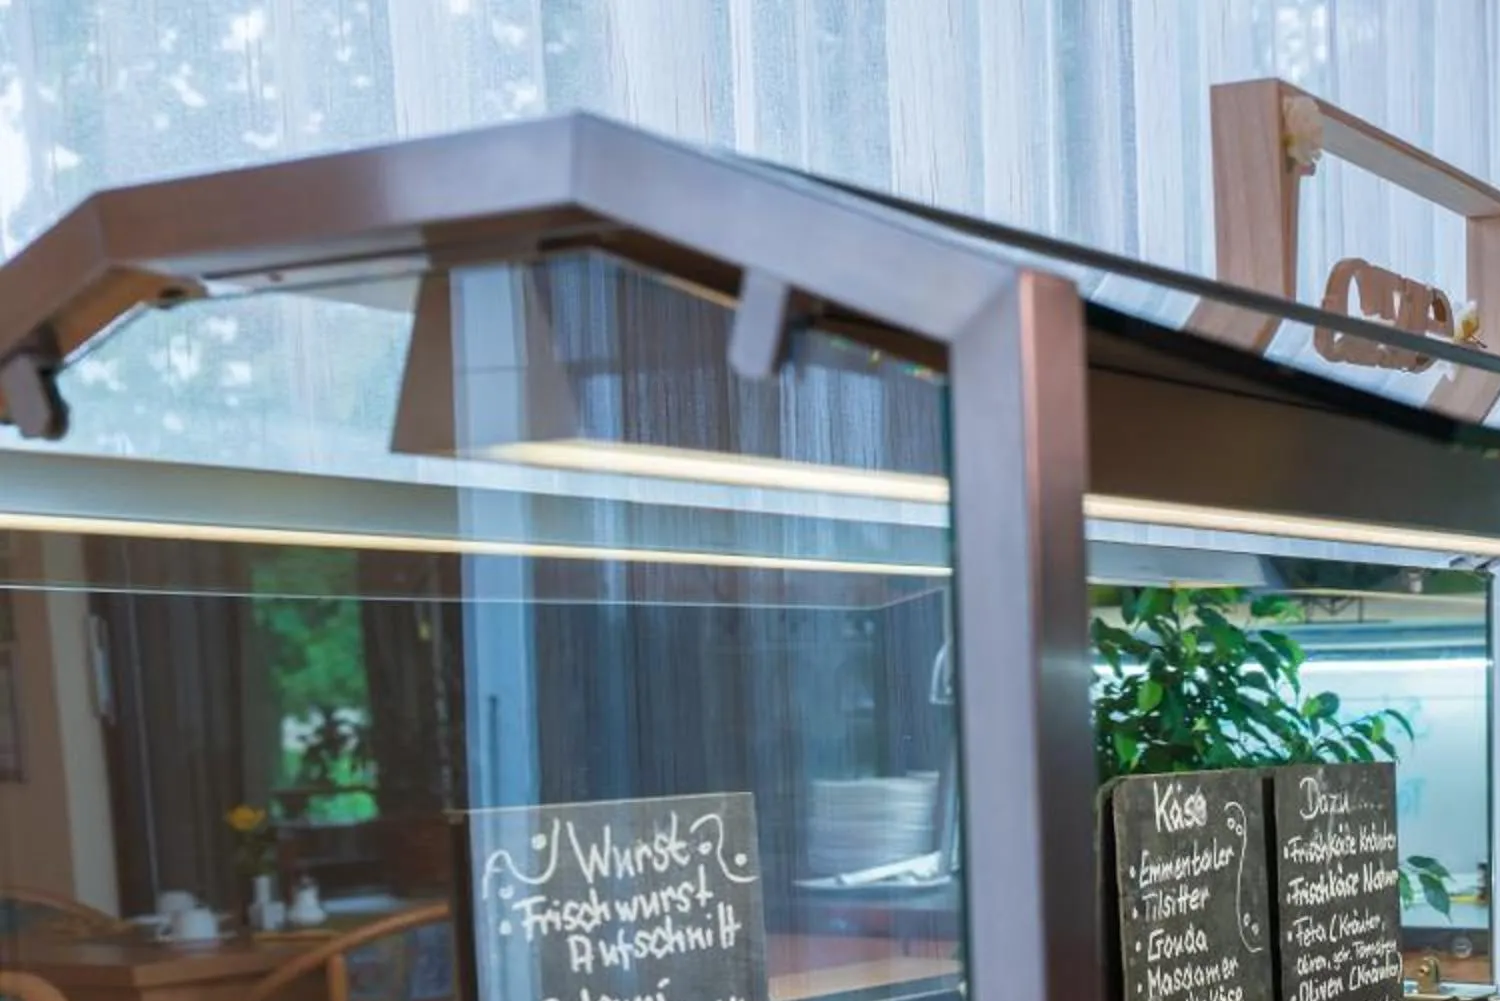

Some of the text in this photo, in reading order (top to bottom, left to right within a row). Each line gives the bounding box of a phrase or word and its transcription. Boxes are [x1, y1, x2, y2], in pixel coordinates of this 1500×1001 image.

[1153, 780, 1208, 833] Käse
[566, 811, 691, 884] Wurst
[1139, 837, 1235, 889] Emmentaler
[1141, 883, 1211, 923] Tilsitter
[566, 901, 742, 975] Aufschnitt
[1147, 922, 1209, 962] Gouda
